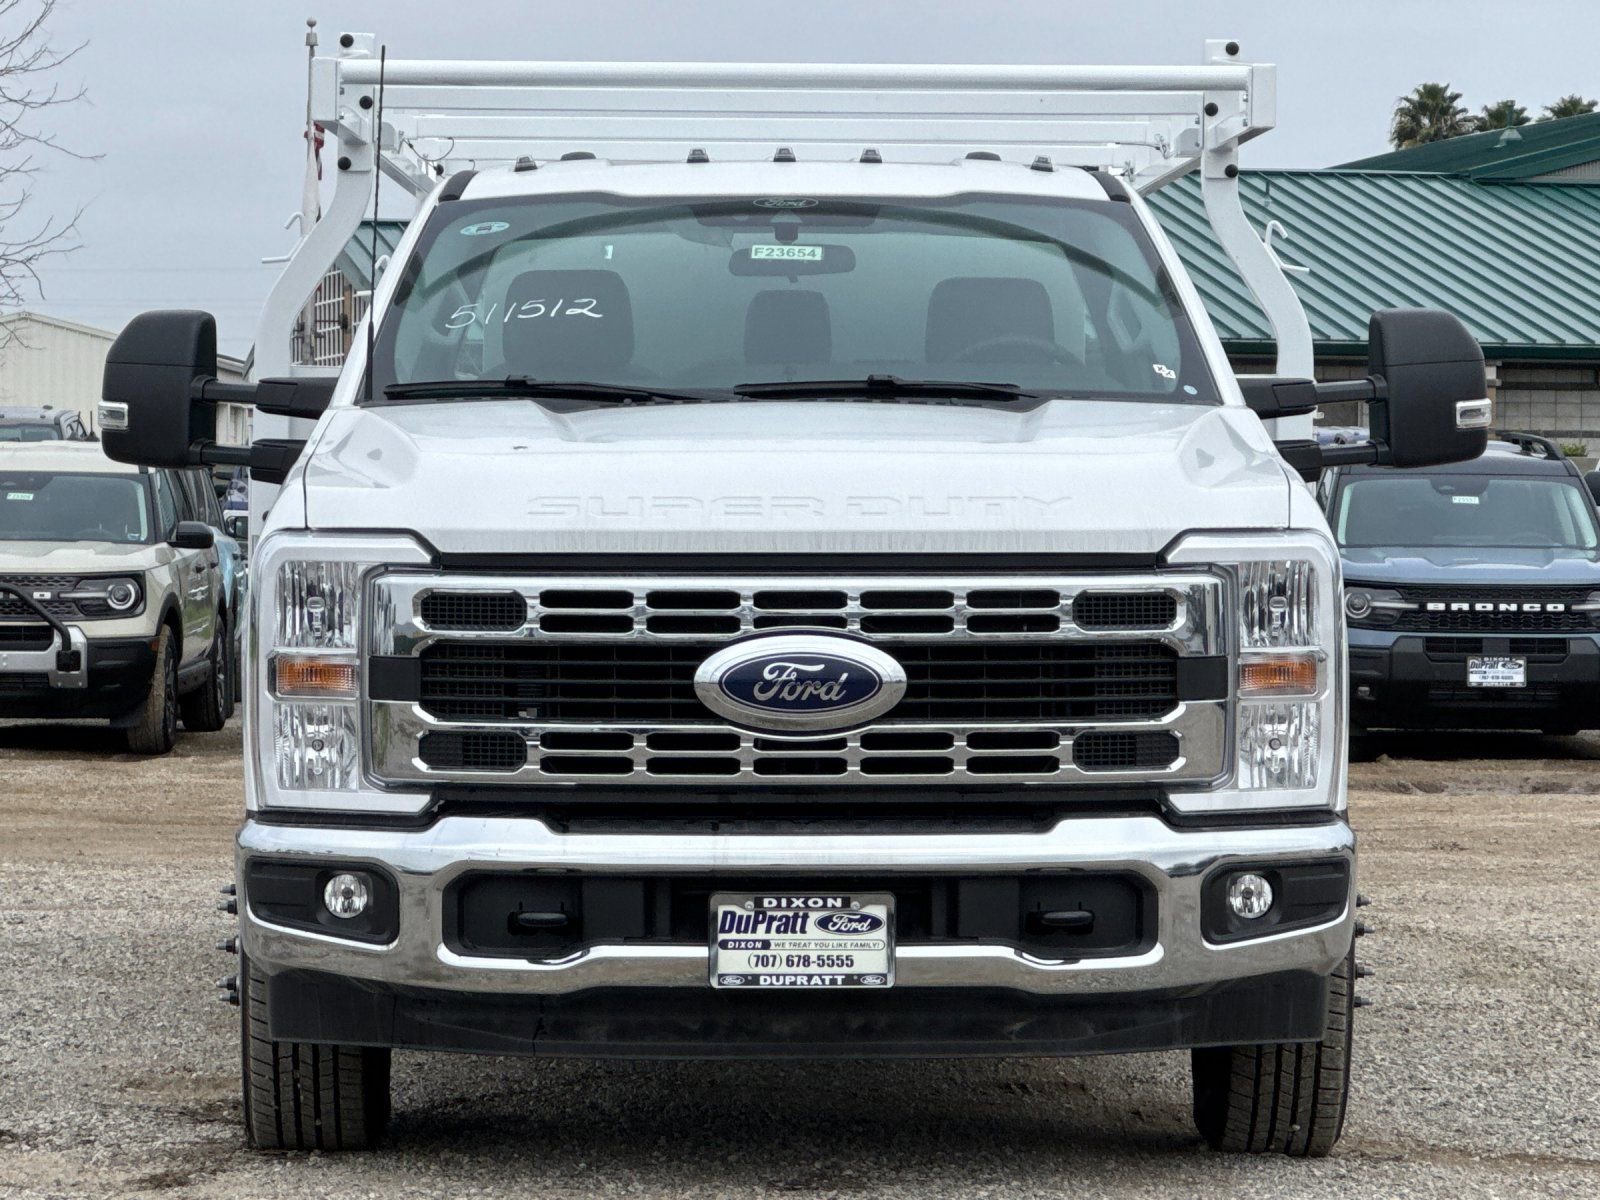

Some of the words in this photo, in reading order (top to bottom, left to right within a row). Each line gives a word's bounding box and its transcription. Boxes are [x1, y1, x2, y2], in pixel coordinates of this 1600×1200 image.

[753, 247, 818, 259] F23654
[445, 298, 603, 329] 511512
[527, 495, 825, 518] SUPER
[846, 495, 1074, 518] DUTY
[1427, 602, 1565, 612] BRONCO
[753, 661, 849, 701] Ford
[763, 897, 843, 909] DIXON
[718, 910, 809, 935] DuPratt
[828, 914, 872, 932] Ford
[727, 941, 762, 949] DIXON
[774, 941, 786, 949] WE
[788, 941, 812, 949] TREAT
[814, 941, 830, 949] YOU
[831, 941, 848, 949] LIKE
[850, 941, 880, 949] FAMILY!
[747, 953, 783, 969] (707)
[785, 955, 854, 968] 678-5555
[759, 975, 845, 985] DUPRATT
